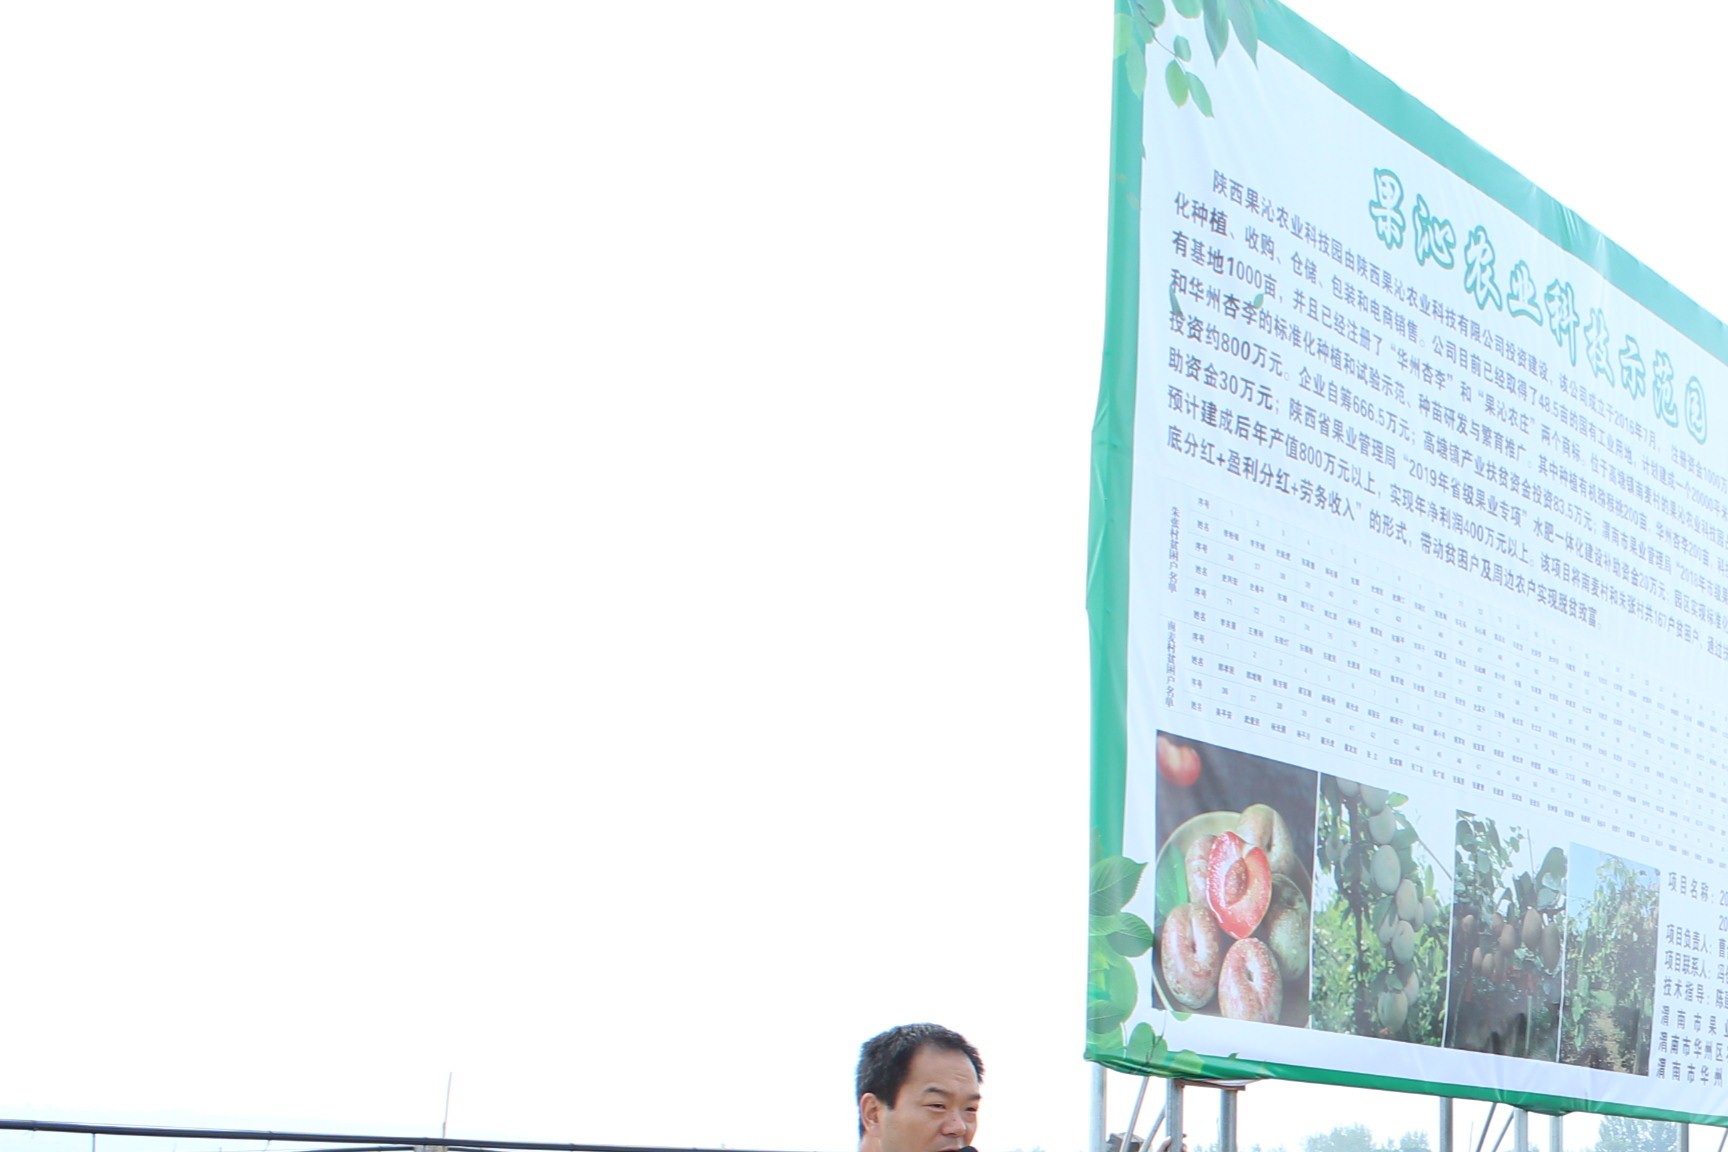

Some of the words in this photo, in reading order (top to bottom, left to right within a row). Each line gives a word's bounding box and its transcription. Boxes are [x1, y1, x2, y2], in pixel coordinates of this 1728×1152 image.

[1368, 168, 1708, 445] 果沁农业科技示范园
